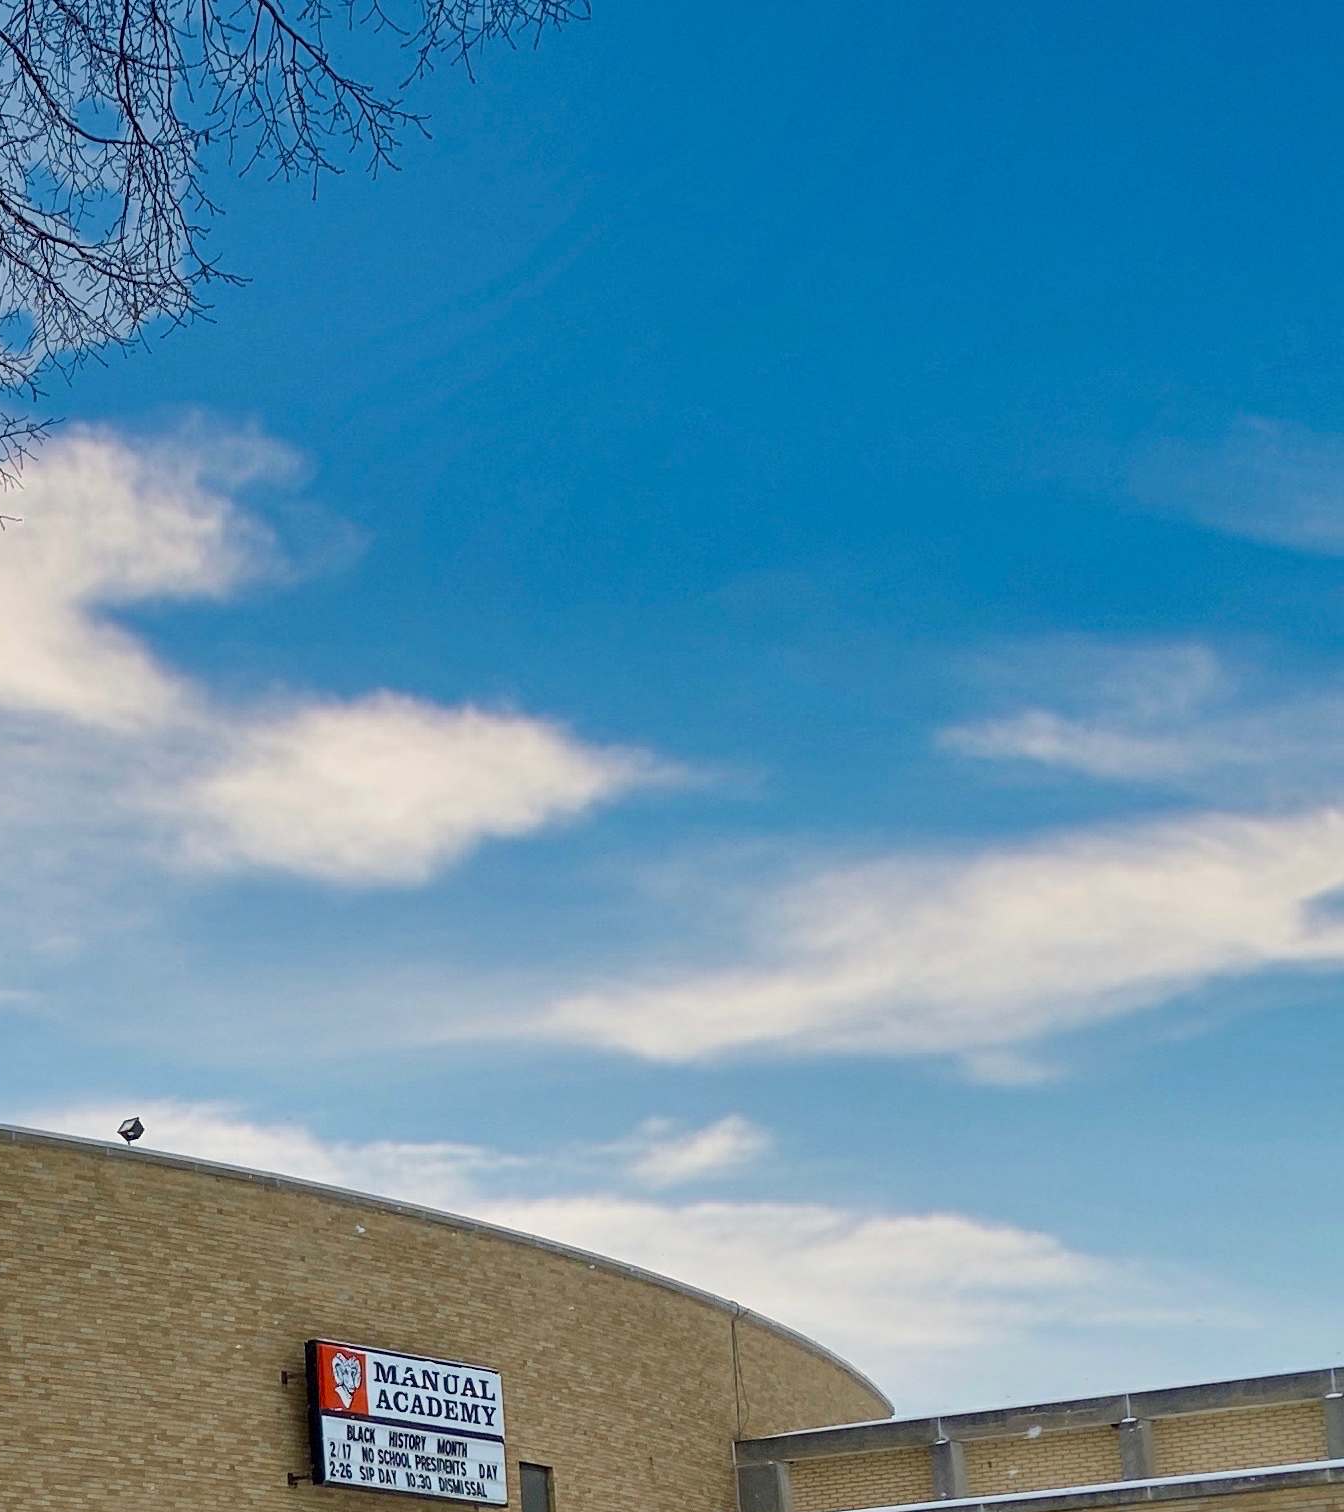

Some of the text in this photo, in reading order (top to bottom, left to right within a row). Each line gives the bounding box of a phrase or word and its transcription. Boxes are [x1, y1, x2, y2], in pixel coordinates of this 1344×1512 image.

[373, 1361, 496, 1402] MANUAL
[375, 1389, 496, 1426] ACADEMY
[346, 1424, 468, 1458] BLACK HISTORY MONTH
[329, 1441, 498, 1481] 2/17 NO SCHOOL PRESIDENTS DAY
[329, 1460, 488, 1498] 2-26 SIP DAY 10:30 DISMISSAL
